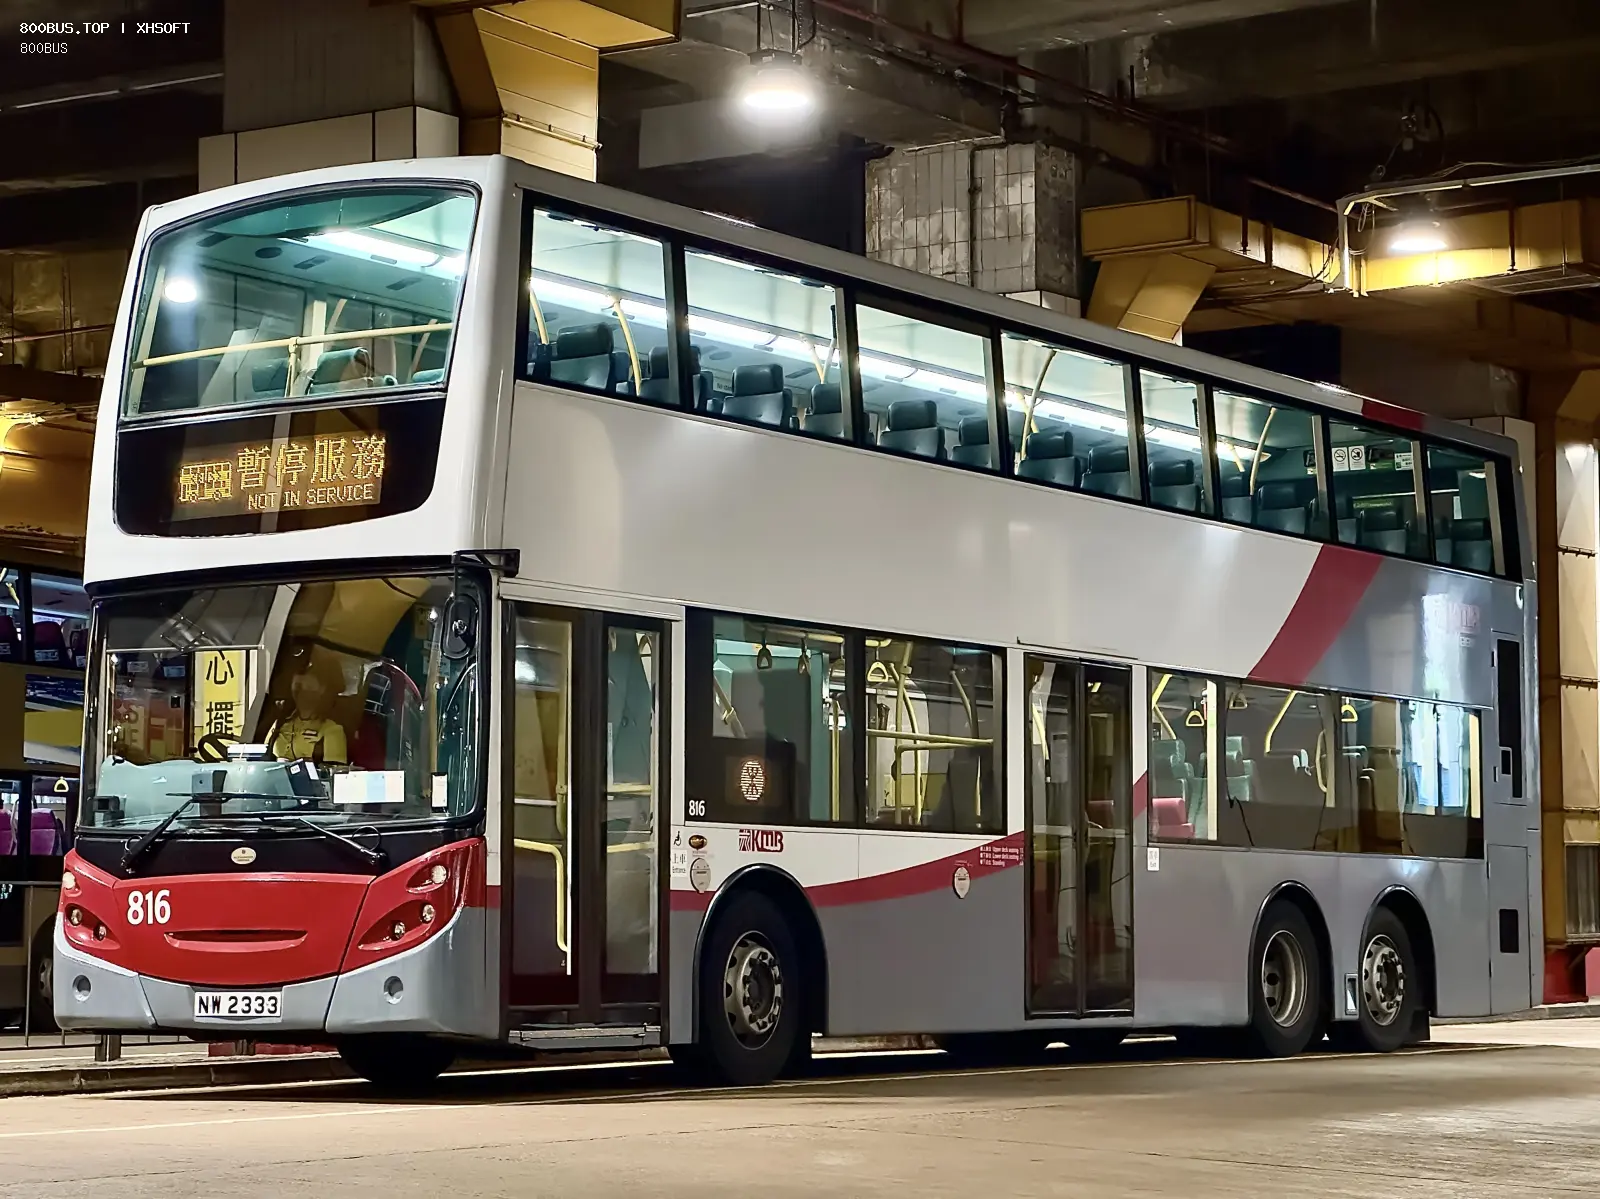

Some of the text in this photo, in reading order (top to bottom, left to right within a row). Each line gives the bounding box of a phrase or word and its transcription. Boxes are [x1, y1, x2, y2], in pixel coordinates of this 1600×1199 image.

[236, 434, 386, 489] 暫停服務
[248, 483, 374, 510] NOT IN SERVICE
[688, 799, 706, 817] 816
[752, 829, 785, 853] KMB
[127, 888, 171, 925] 816
[198, 995, 278, 1014] NW 2333
